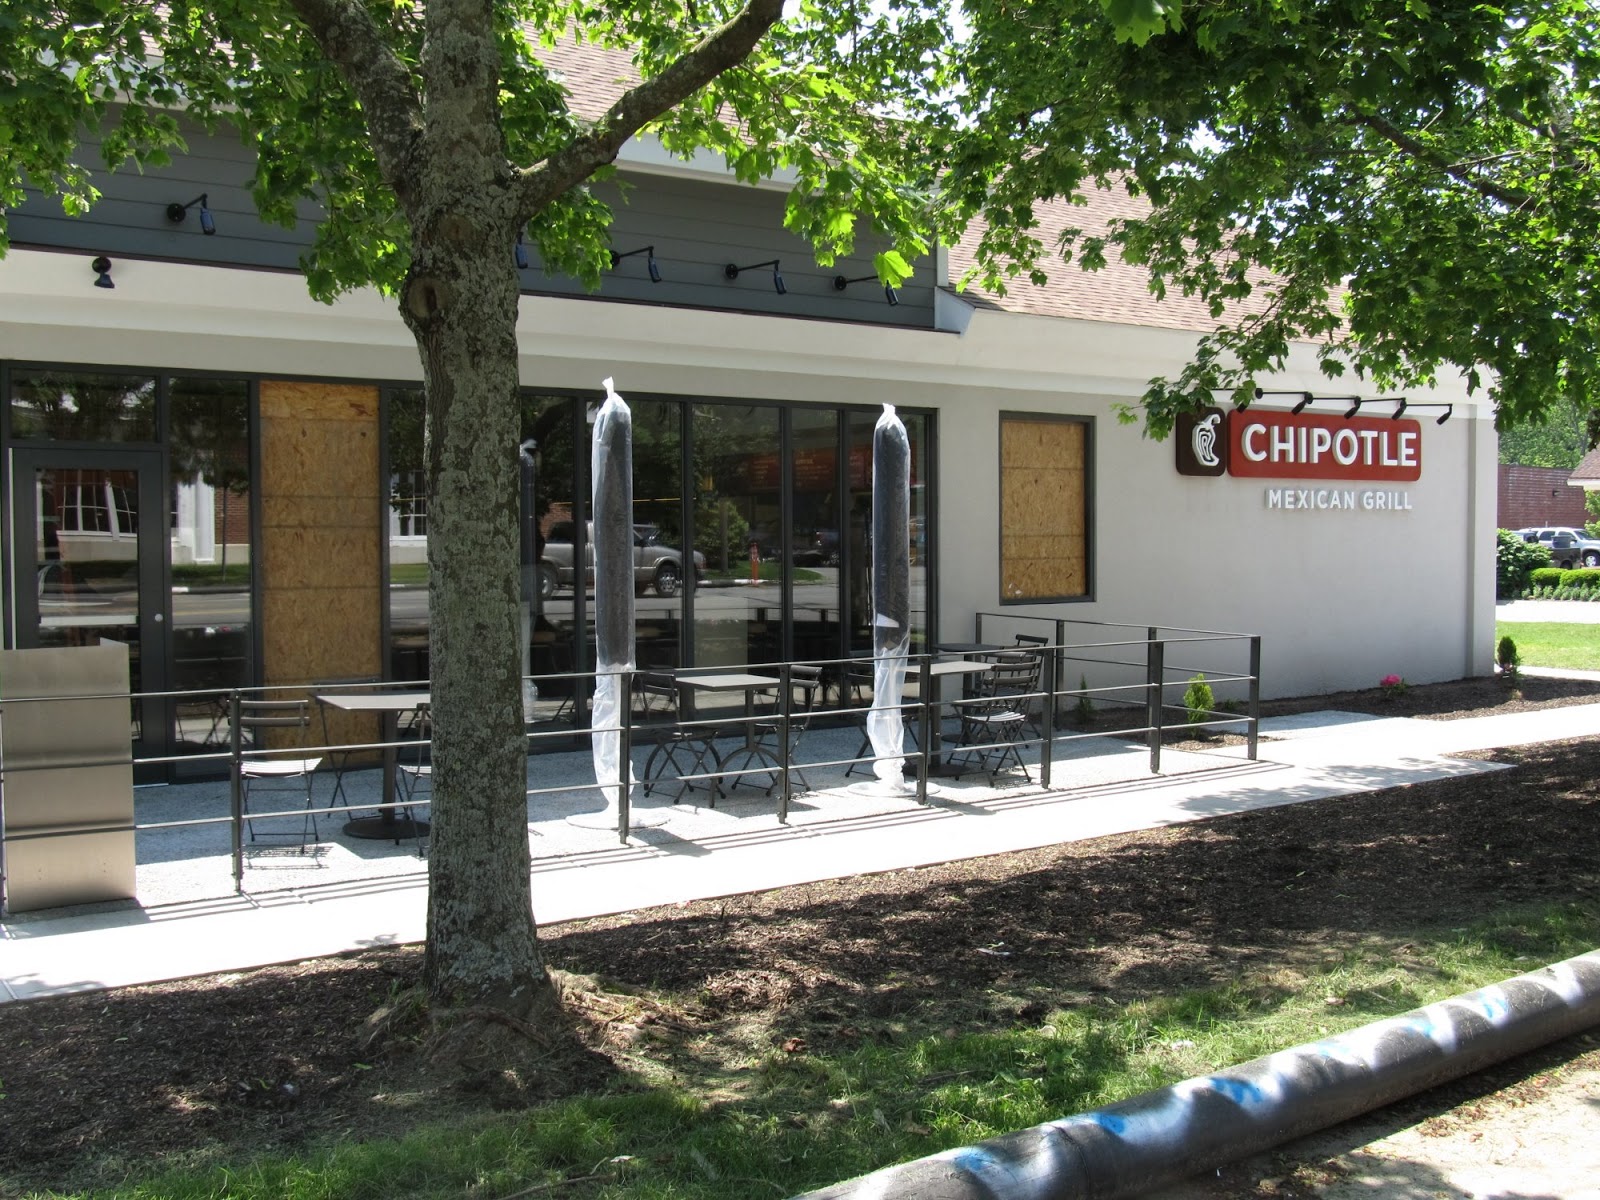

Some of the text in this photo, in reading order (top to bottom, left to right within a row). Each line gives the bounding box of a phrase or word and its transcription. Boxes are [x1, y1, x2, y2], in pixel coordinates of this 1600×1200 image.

[1241, 423, 1417, 467] CHIPOTLE
[1267, 489, 1412, 511] MEXICAN GRILL
